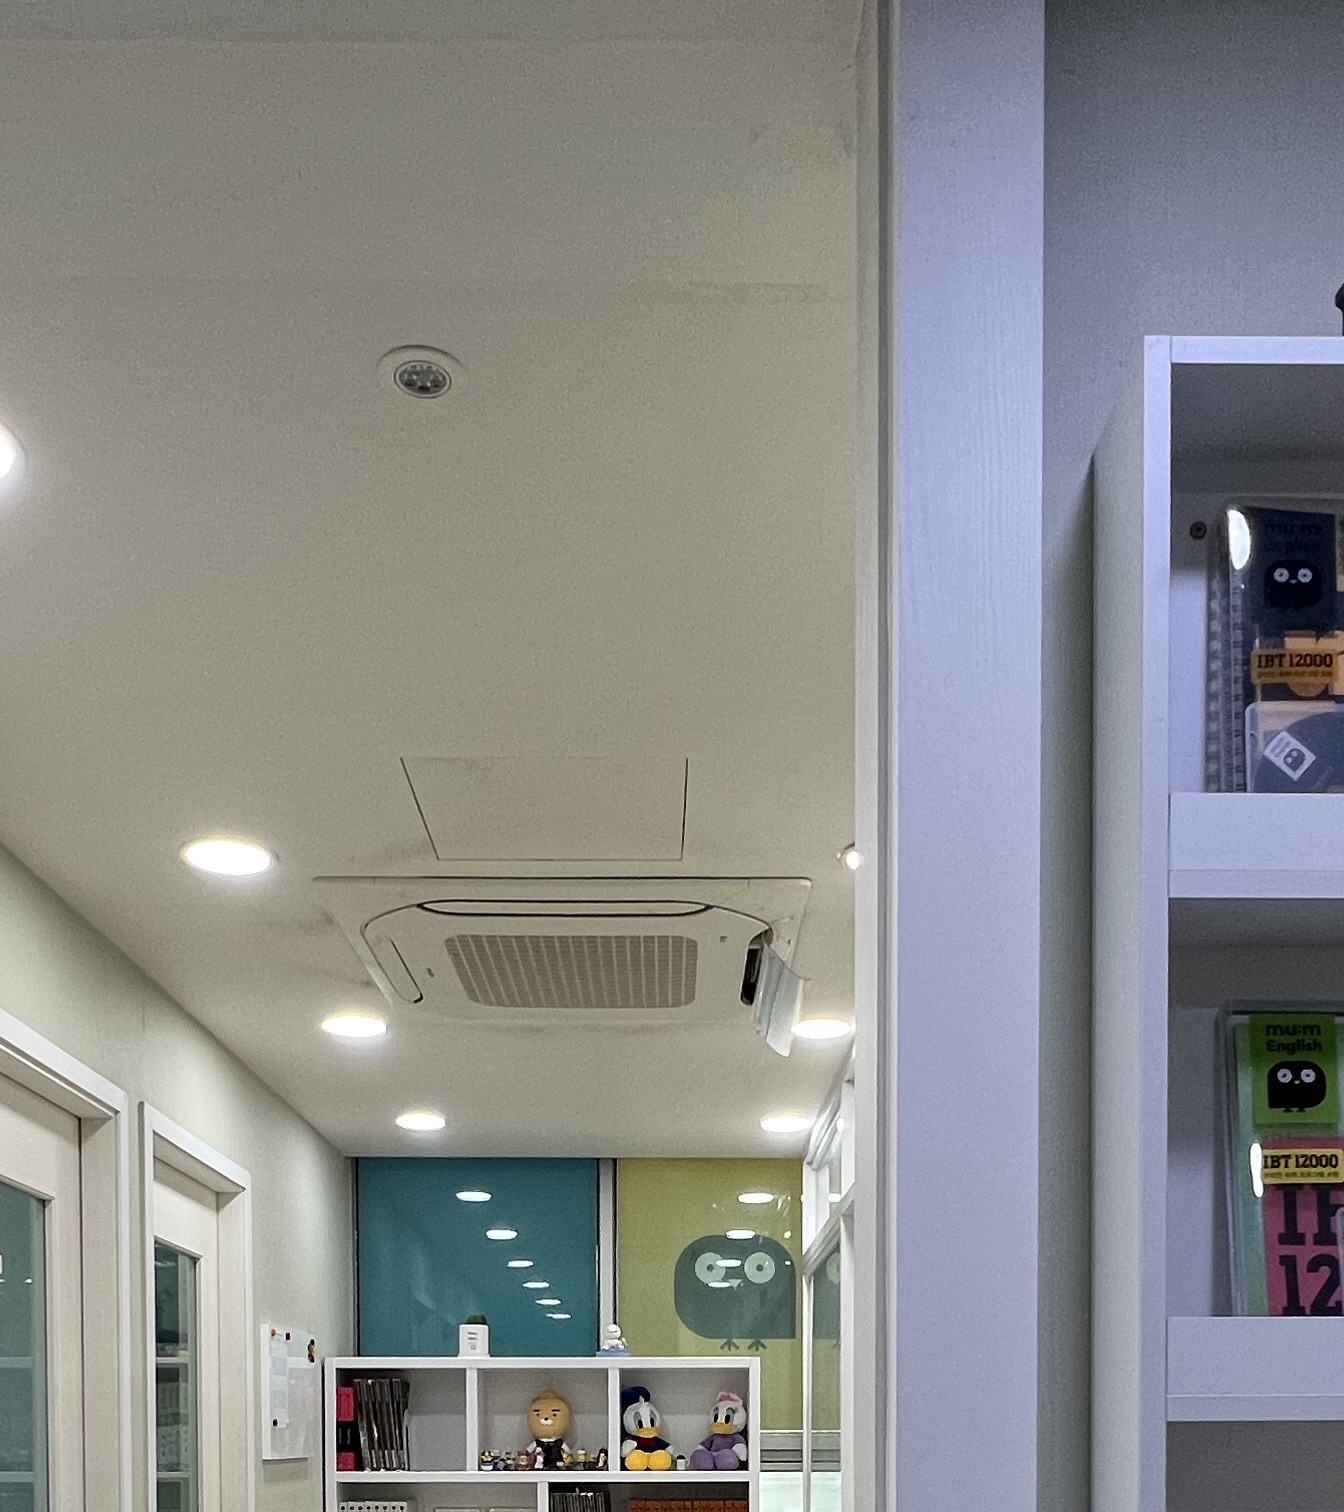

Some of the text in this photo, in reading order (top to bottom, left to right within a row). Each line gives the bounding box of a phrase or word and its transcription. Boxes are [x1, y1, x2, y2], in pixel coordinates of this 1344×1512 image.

[1257, 653, 1334, 669] IBT 12000
[1265, 1039, 1324, 1055] English
[1263, 1153, 1339, 1169] IBT 12000
